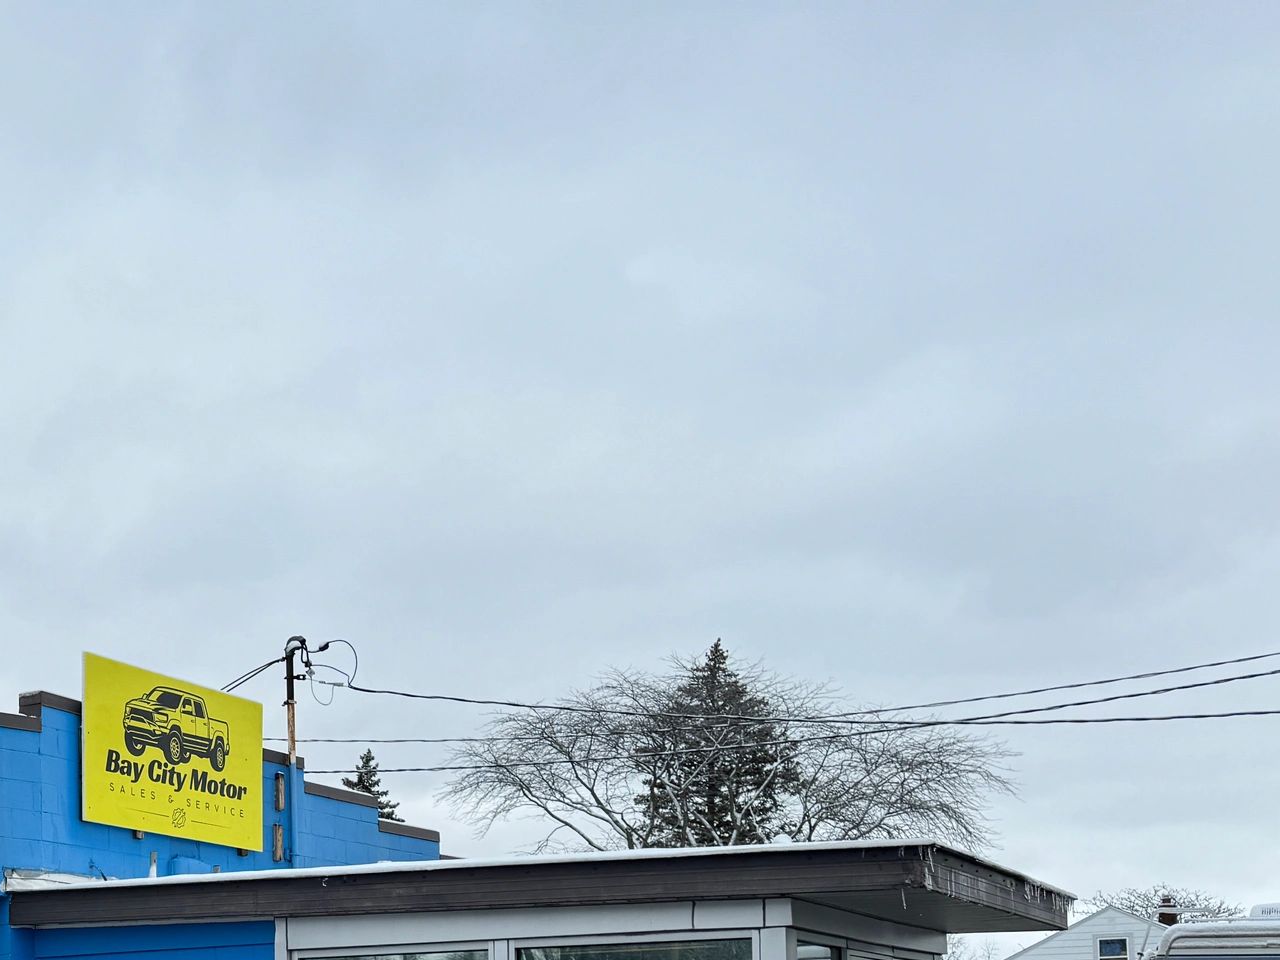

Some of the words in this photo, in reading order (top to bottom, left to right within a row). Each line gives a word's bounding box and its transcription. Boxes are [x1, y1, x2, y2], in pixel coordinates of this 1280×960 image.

[105, 749, 145, 783] Bay
[148, 759, 187, 792] City
[189, 769, 248, 800] Motor
[109, 782, 156, 800] SALES
[167, 794, 175, 804] &
[186, 798, 245, 818] SERVICE
